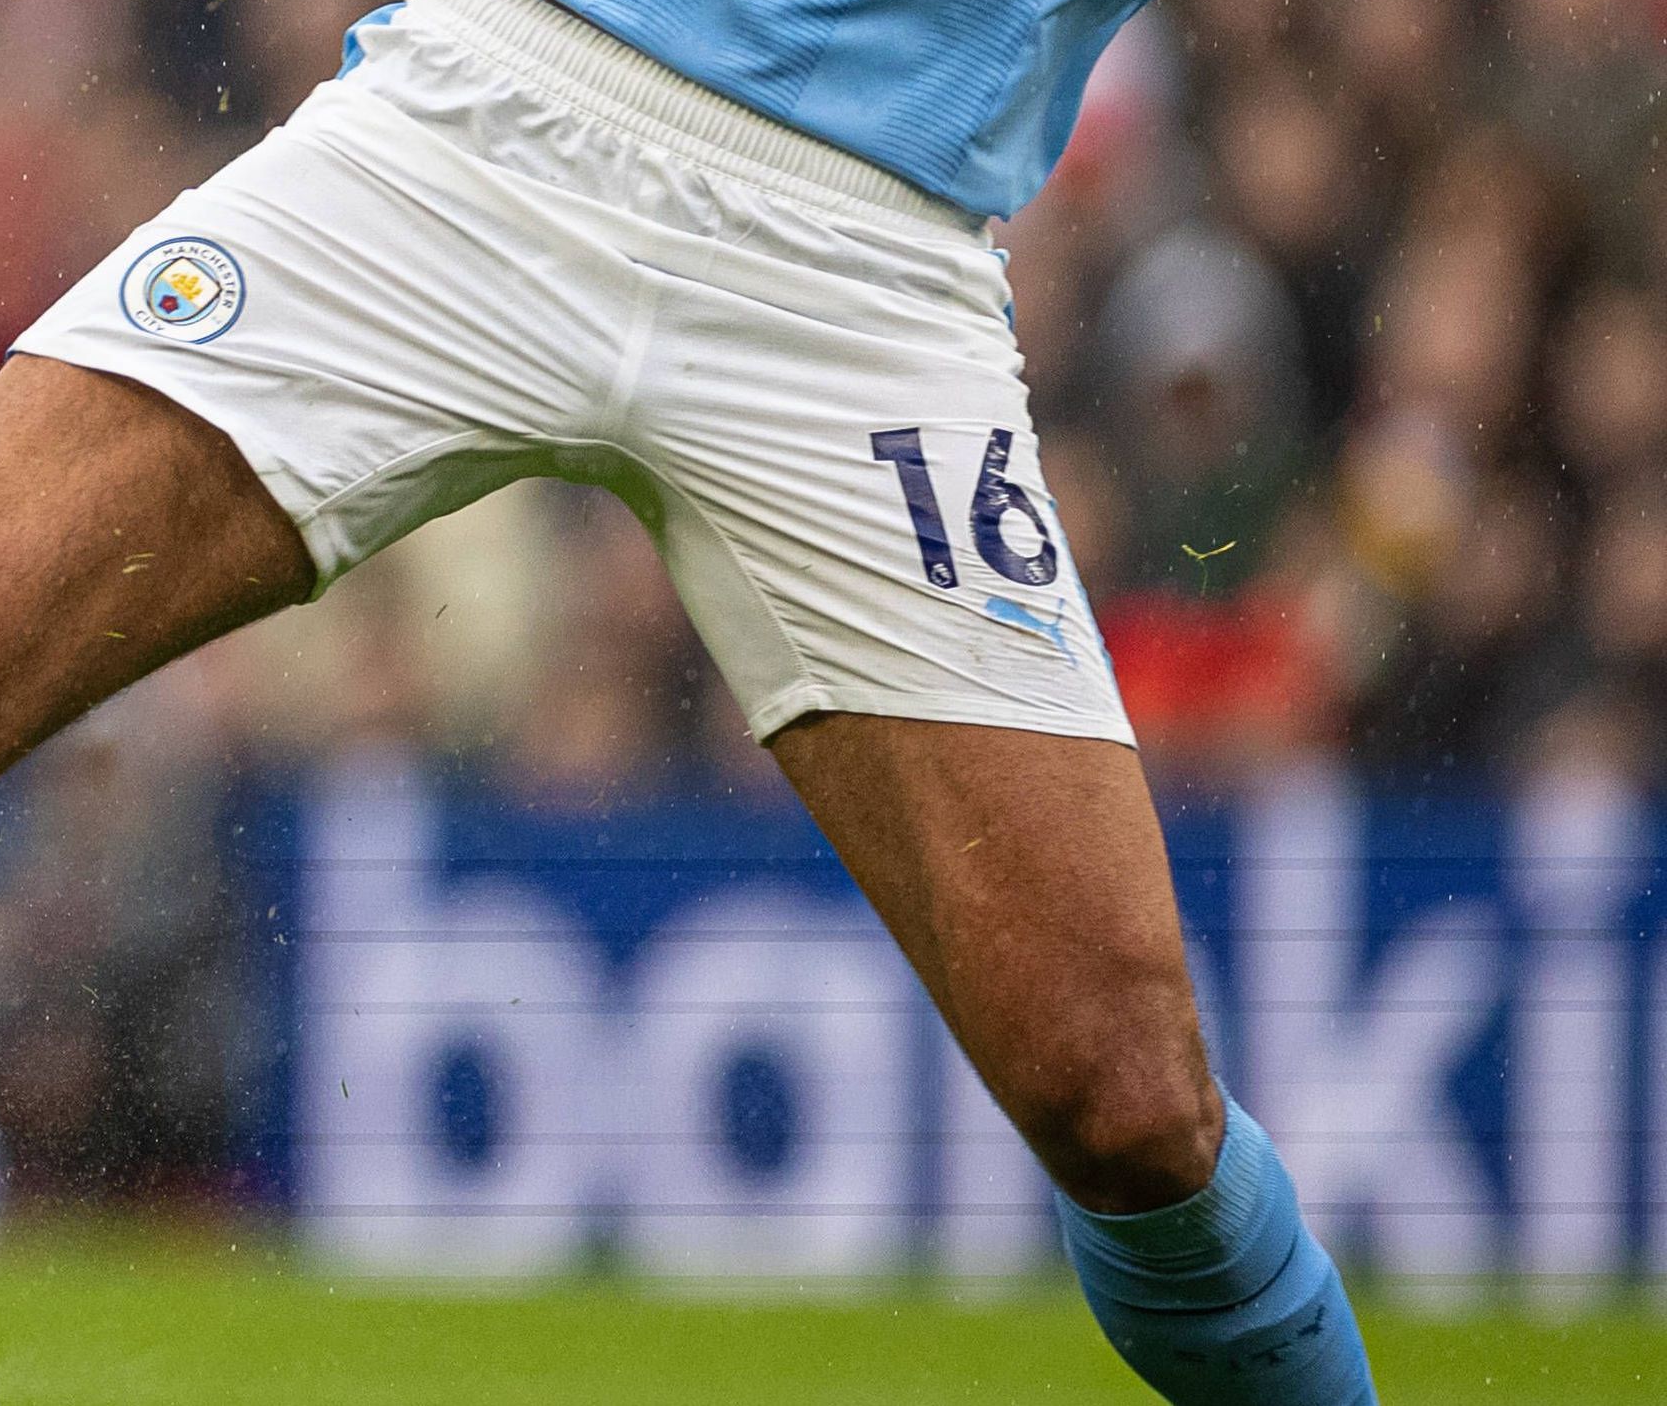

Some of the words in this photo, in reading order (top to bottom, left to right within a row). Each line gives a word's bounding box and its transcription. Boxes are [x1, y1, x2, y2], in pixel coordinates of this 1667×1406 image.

[162, 245, 237, 310] MANCHESTER
[134, 309, 166, 332] CITY
[869, 426, 1058, 590] 16
